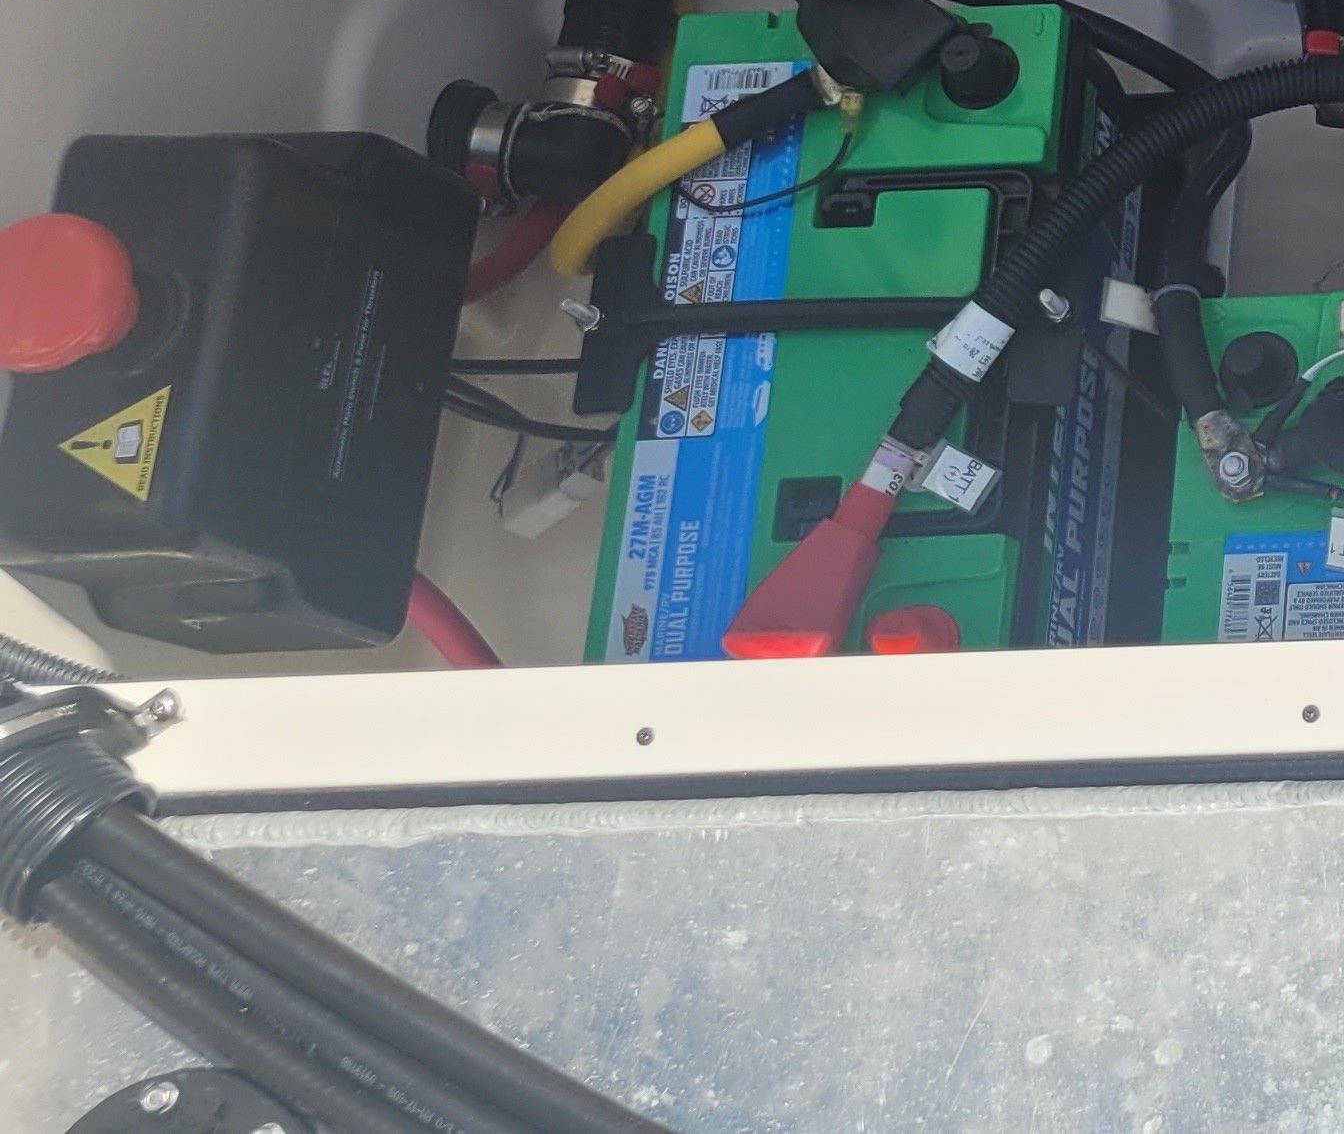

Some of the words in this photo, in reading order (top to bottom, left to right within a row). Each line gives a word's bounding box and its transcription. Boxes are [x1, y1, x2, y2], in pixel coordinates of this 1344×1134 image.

[664, 253, 680, 301] OISON
[142, 394, 165, 465] INSTRUCTIONS
[885, 473, 904, 497] 103
[957, 458, 983, 495] BATT
[629, 474, 657, 560] 27M-AGM
[647, 547, 659, 569] MCA
[671, 519, 701, 602] PURPOSE
[644, 570, 656, 591] 975
[665, 603, 688, 656] DUAL
[1261, 607, 1272, 616] Pb
